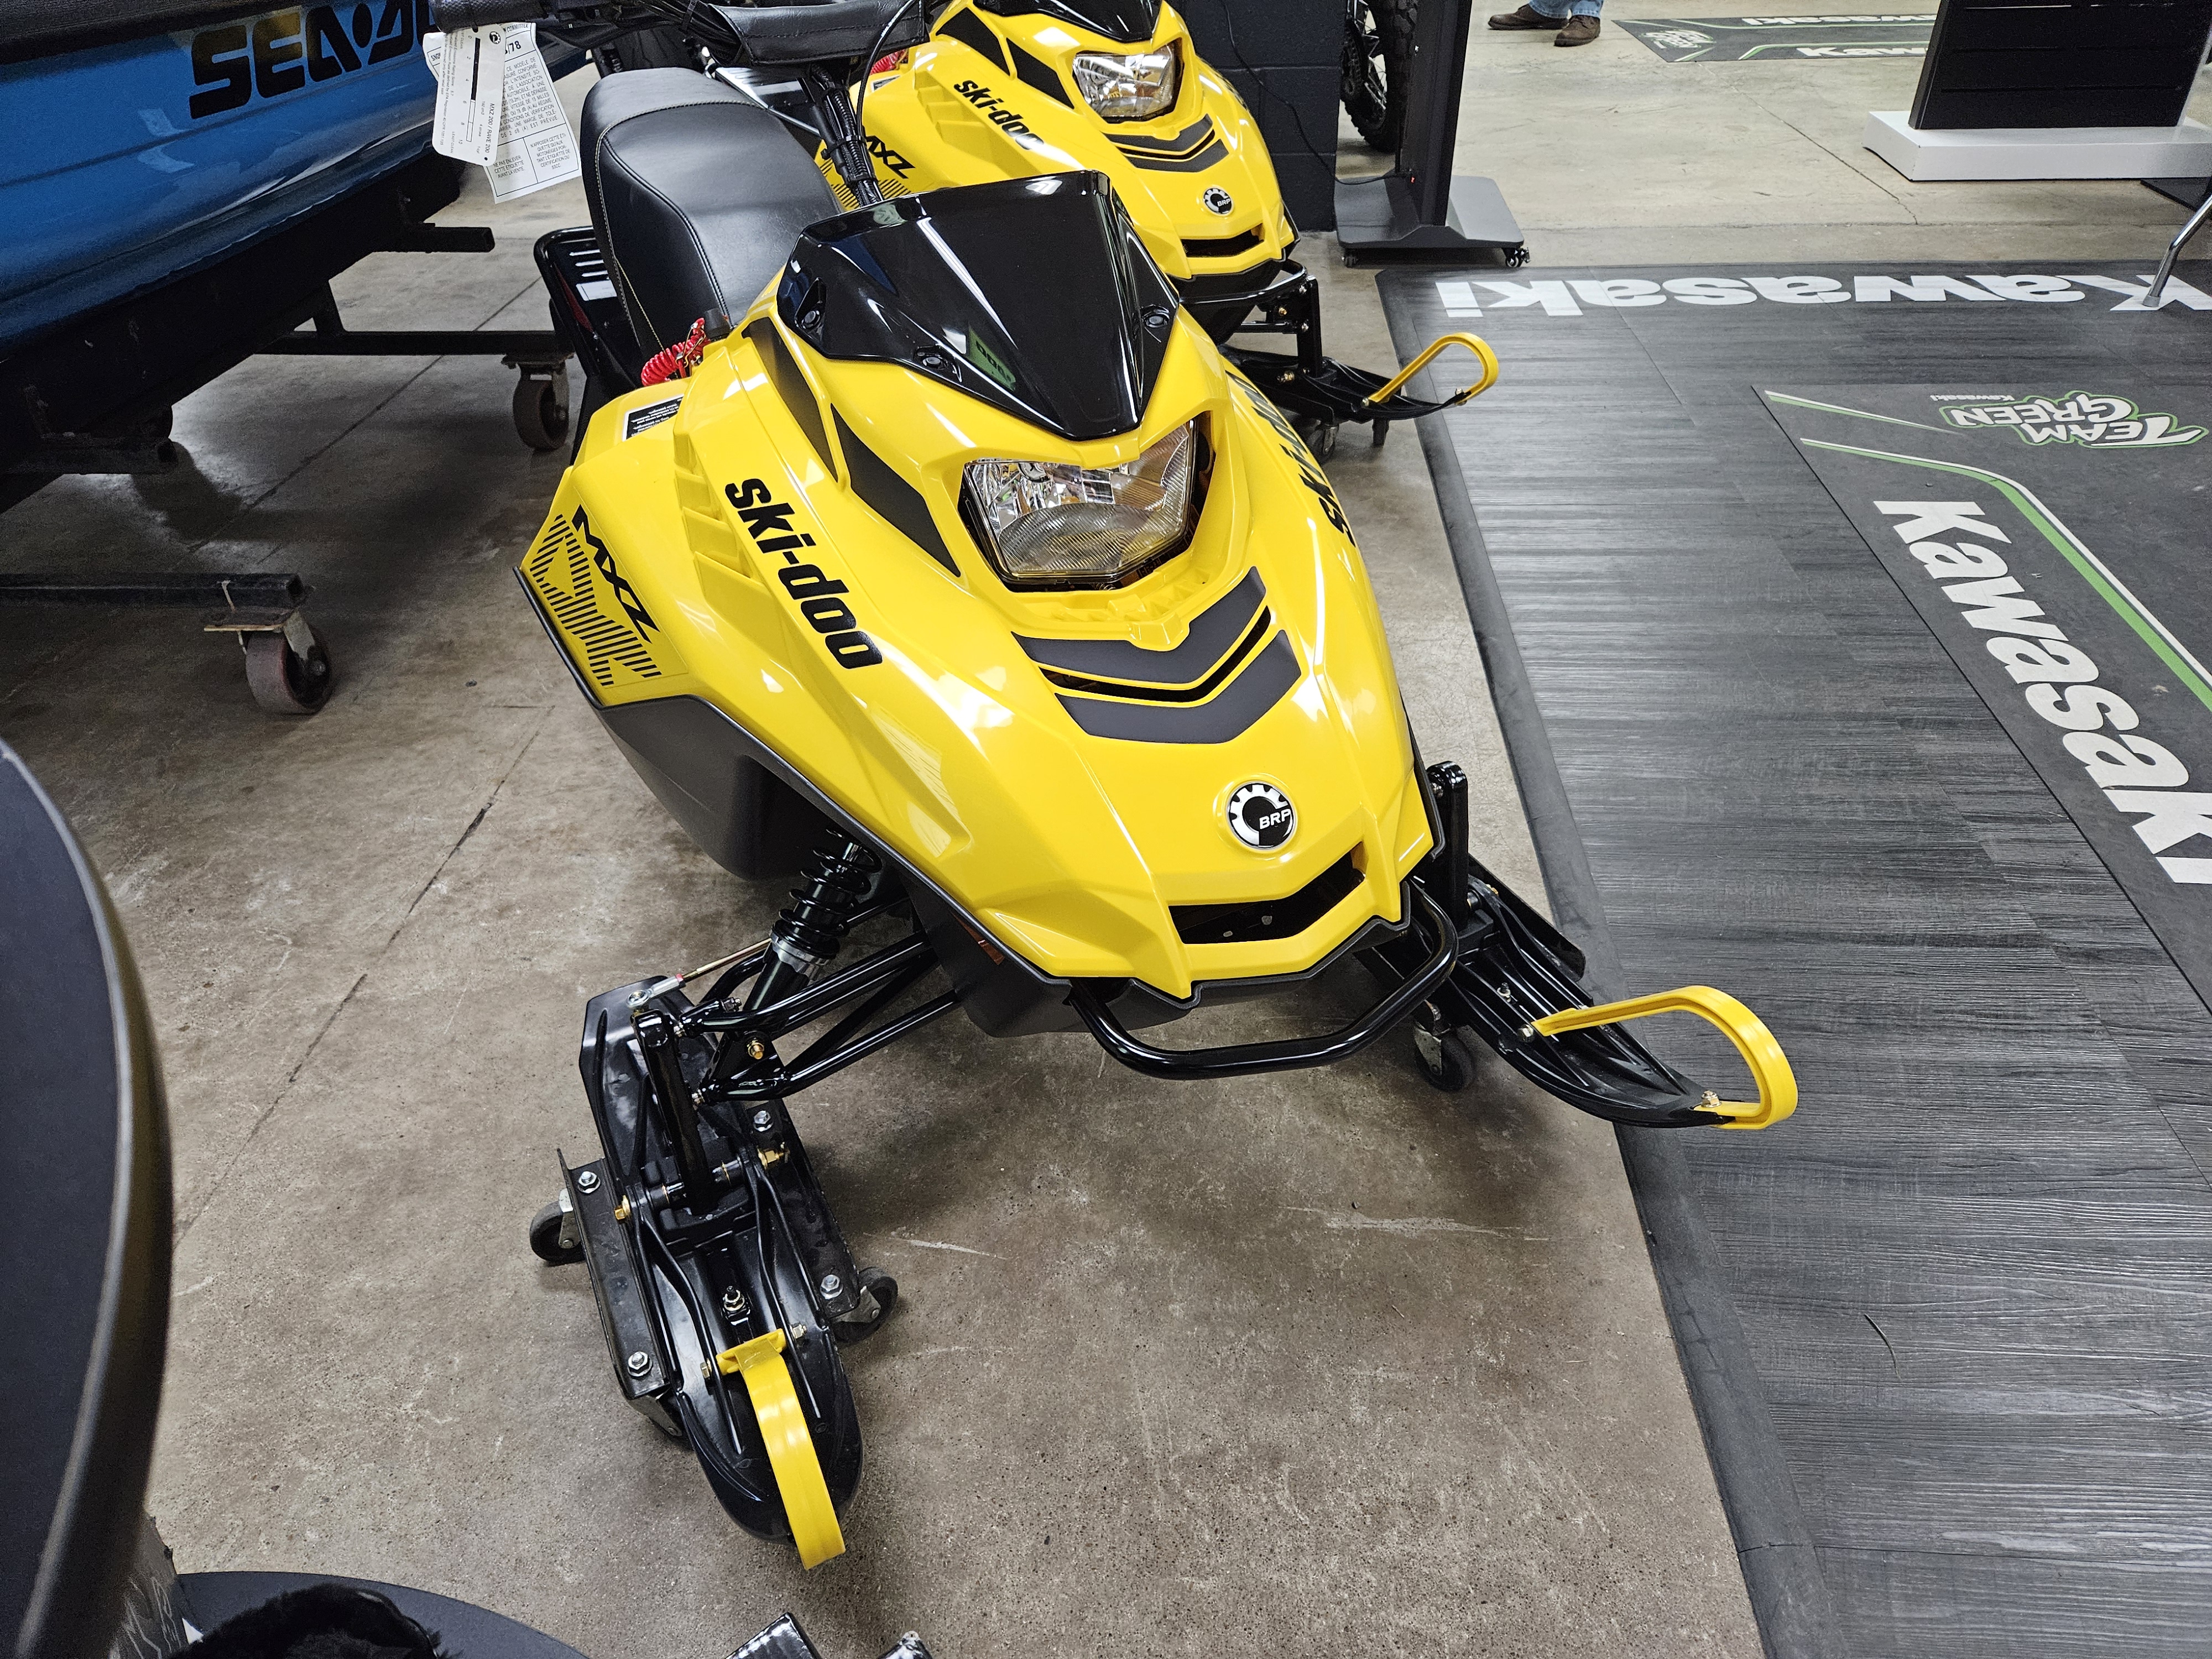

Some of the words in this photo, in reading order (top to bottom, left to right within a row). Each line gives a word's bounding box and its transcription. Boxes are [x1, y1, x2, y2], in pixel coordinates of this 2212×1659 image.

[510, 101, 525, 109] VITESSE
[954, 80, 1044, 150] ski-doo
[1950, 393, 2132, 426] GREEN
[2020, 416, 2201, 446] TEAM
[571, 504, 660, 643] MXZ
[724, 478, 883, 670] ski-doo
[1259, 808, 1291, 830] BRP
